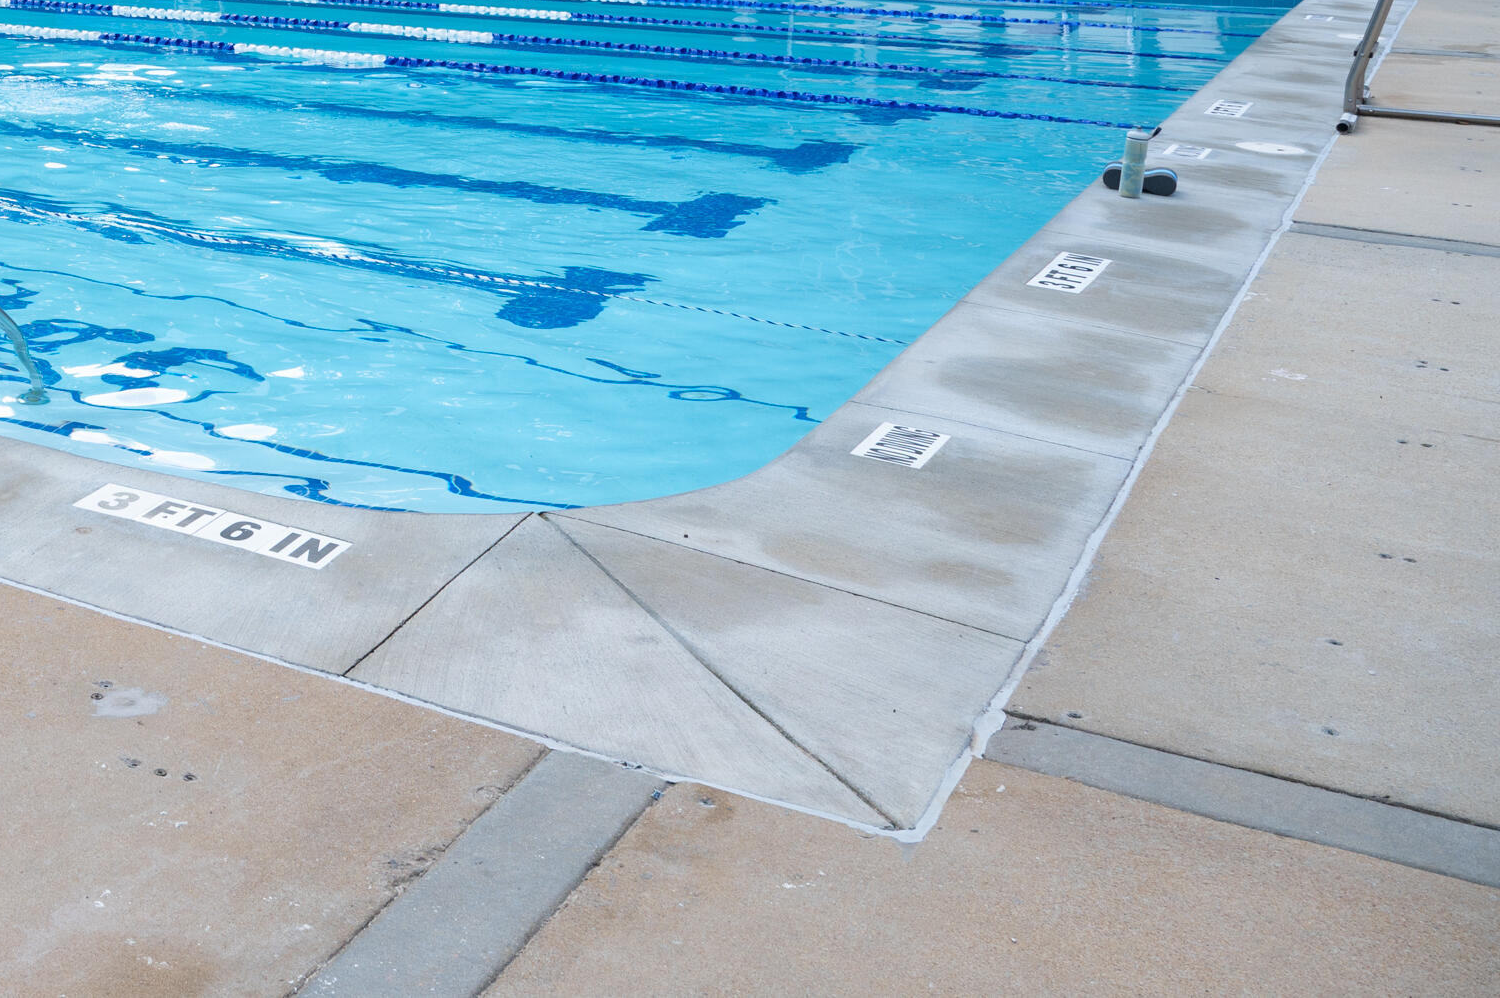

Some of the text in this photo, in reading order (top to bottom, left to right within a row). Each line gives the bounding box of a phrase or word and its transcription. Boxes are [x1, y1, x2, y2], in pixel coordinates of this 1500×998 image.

[1038, 253, 1104, 290] 3 FT 6 IN
[863, 425, 941, 466] NO DIVING
[98, 491, 340, 564] 3 FT 6 IN
